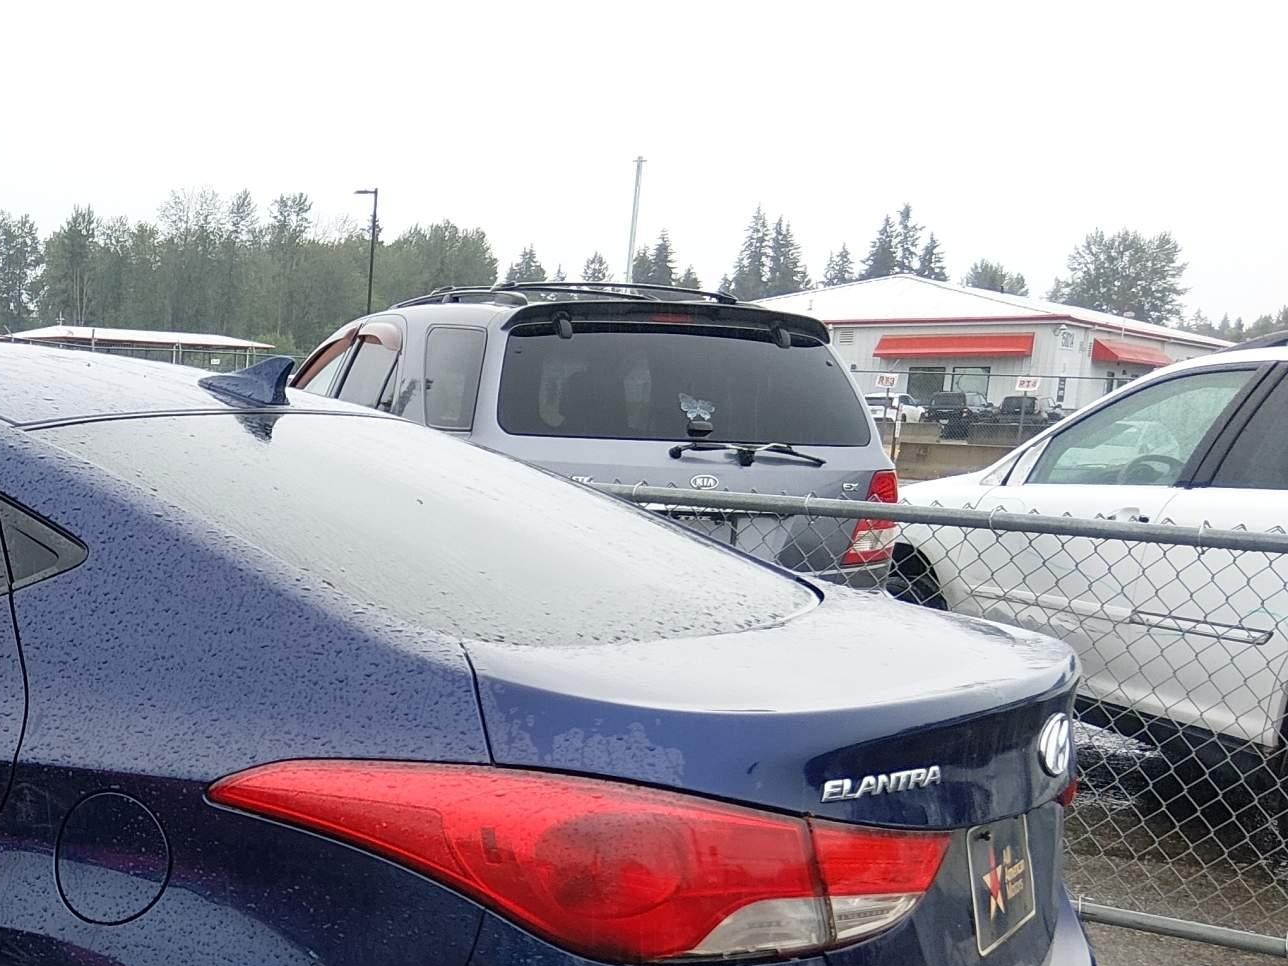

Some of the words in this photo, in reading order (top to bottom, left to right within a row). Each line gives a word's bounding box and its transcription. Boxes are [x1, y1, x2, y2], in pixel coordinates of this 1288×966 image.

[695, 477, 715, 488] KIA
[843, 482, 860, 492] EX
[821, 764, 942, 803] ELANTRA
